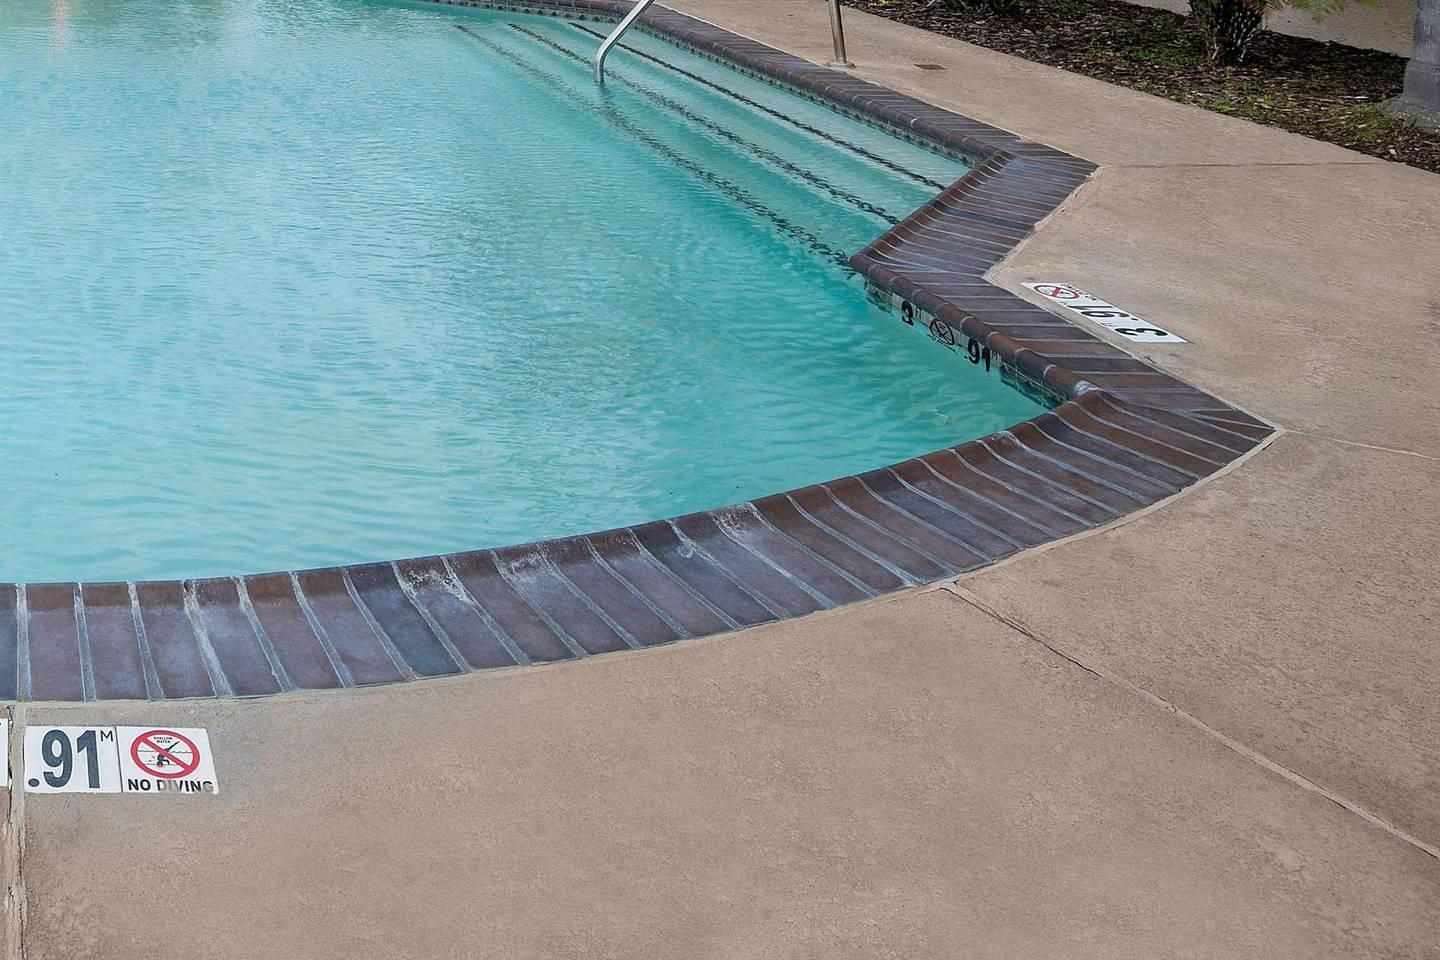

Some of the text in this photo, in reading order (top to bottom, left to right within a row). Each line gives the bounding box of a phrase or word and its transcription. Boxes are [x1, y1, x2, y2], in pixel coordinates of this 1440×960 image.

[901, 300, 914, 326] 3
[27, 729, 113, 789] .91 M
[128, 779, 214, 792] NO DIVING
